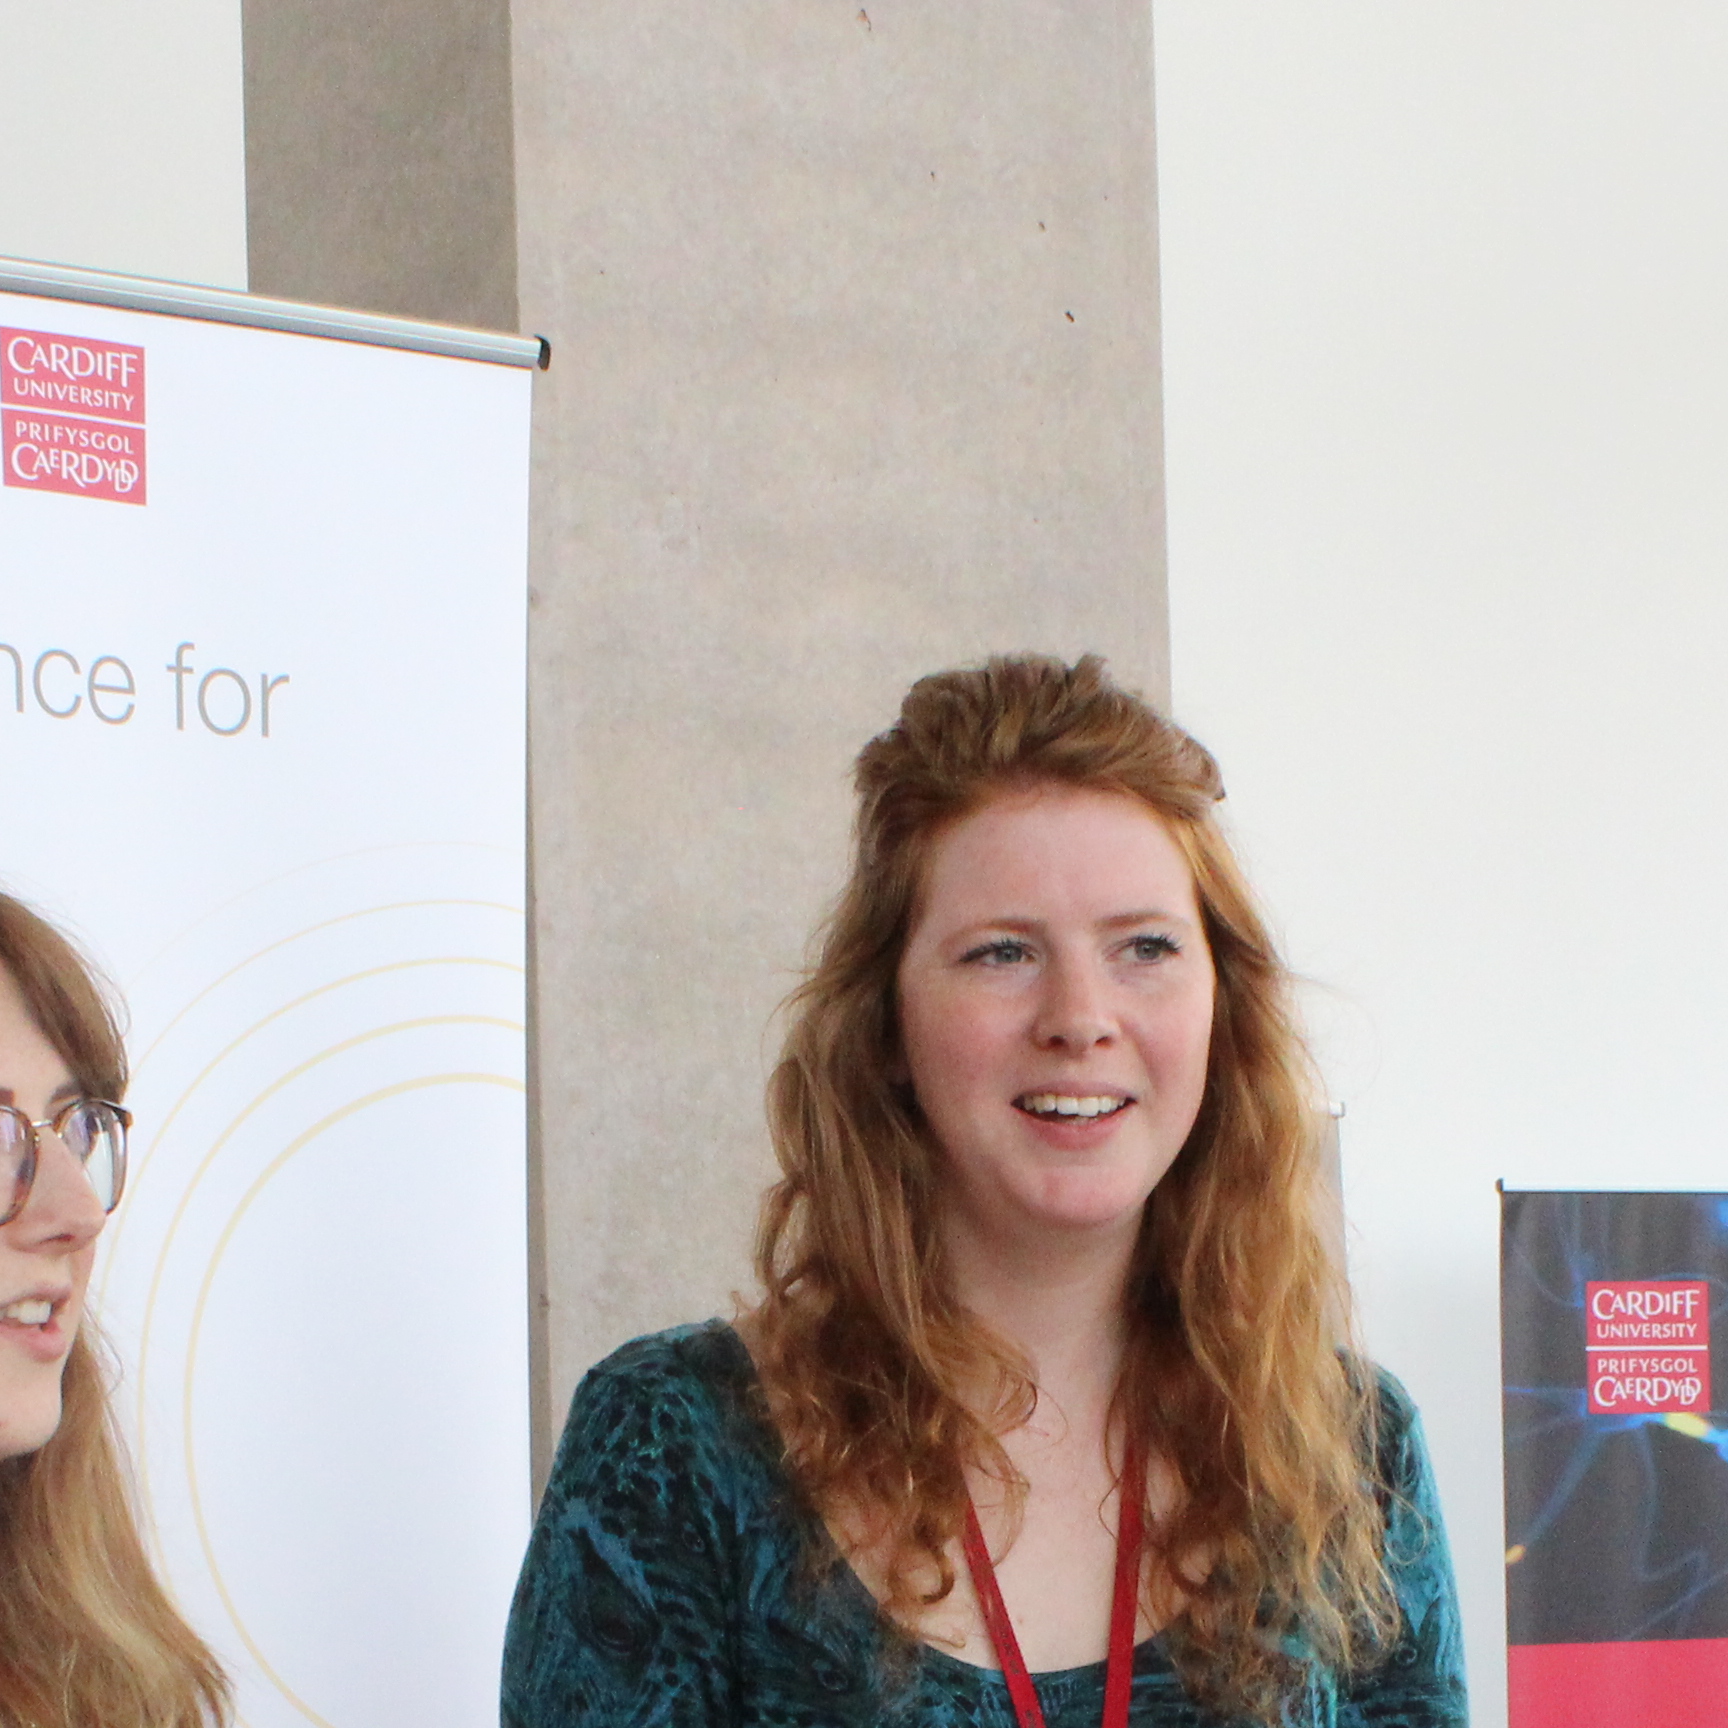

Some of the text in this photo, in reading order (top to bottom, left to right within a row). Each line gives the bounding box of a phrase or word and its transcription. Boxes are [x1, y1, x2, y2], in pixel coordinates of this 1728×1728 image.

[7, 336, 139, 388] CARDIFF
[13, 377, 135, 412] UNIVERSITY
[15, 419, 135, 455] PRIFYSGOL
[11, 442, 140, 493] CAERDYDD
[166, 640, 290, 739] for
[1591, 1288, 1700, 1321] CARDIFF
[1596, 1323, 1698, 1339] UNIVERSITY
[1597, 1357, 1699, 1374] PRIFYSGOL
[1593, 1375, 1703, 1408] CAERDYDD
